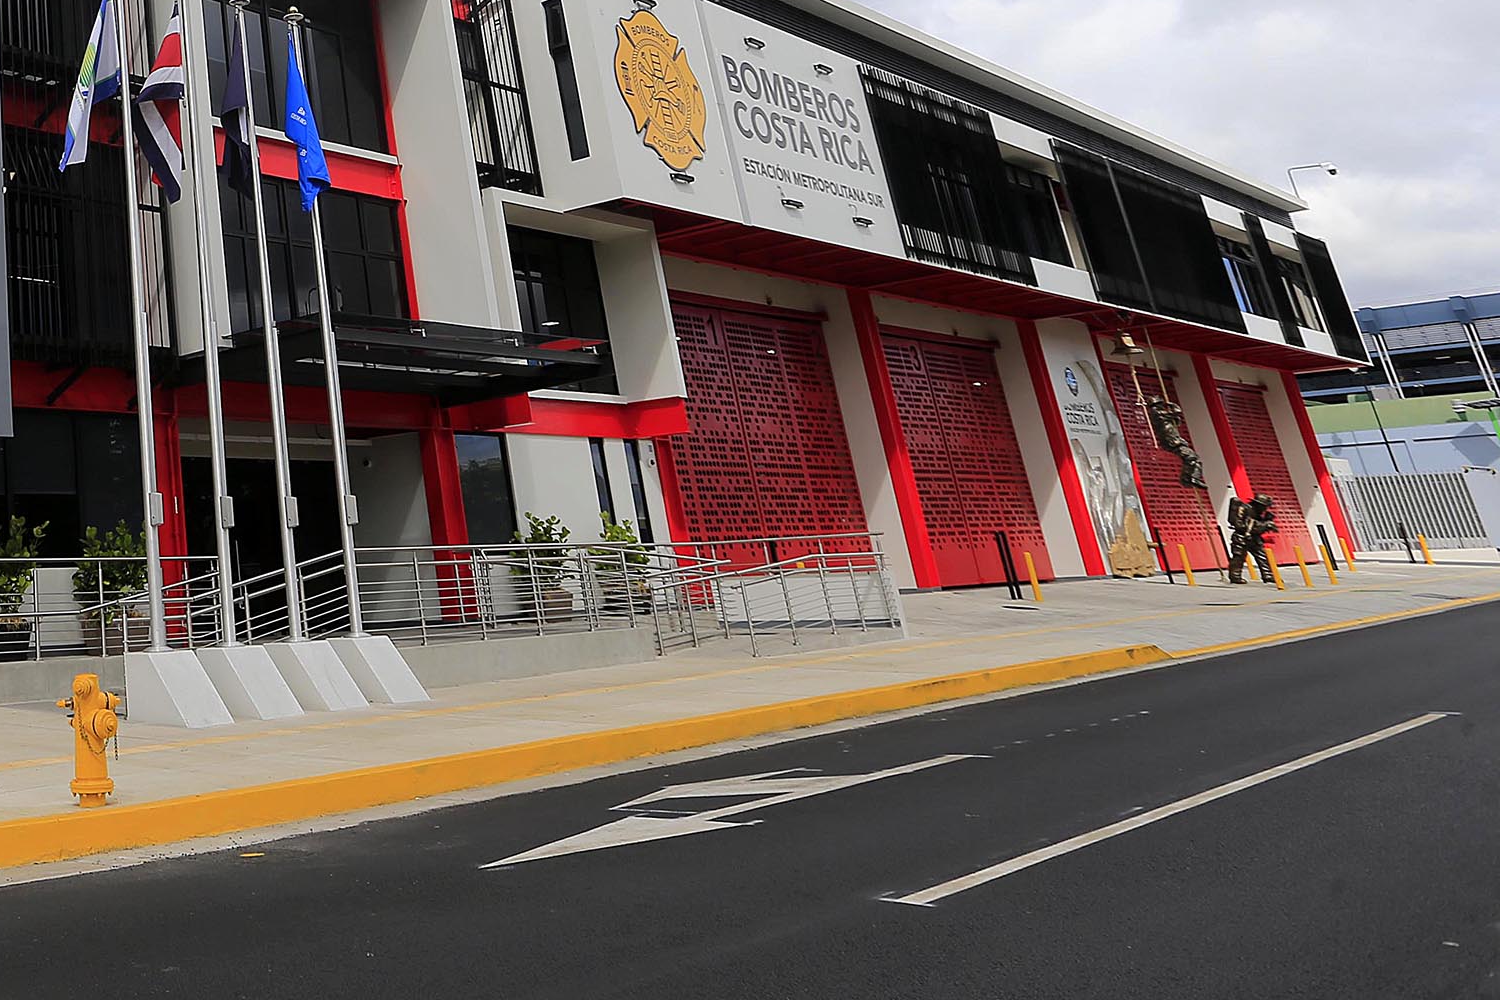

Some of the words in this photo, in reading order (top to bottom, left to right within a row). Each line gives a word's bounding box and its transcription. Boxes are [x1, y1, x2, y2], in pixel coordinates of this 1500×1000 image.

[631, 25, 670, 47] BOMBEROS
[721, 54, 862, 134] BOMBEROS
[653, 135, 677, 154] COSTA
[677, 144, 693, 155] RICA
[733, 101, 818, 159] COSTA
[822, 127, 876, 175] RICA
[743, 157, 792, 185] ESTACIÓN
[792, 172, 866, 204] METROPOLITANA
[867, 192, 885, 209] SUR
[706, 313, 719, 346] 1
[908, 345, 922, 372] 3
